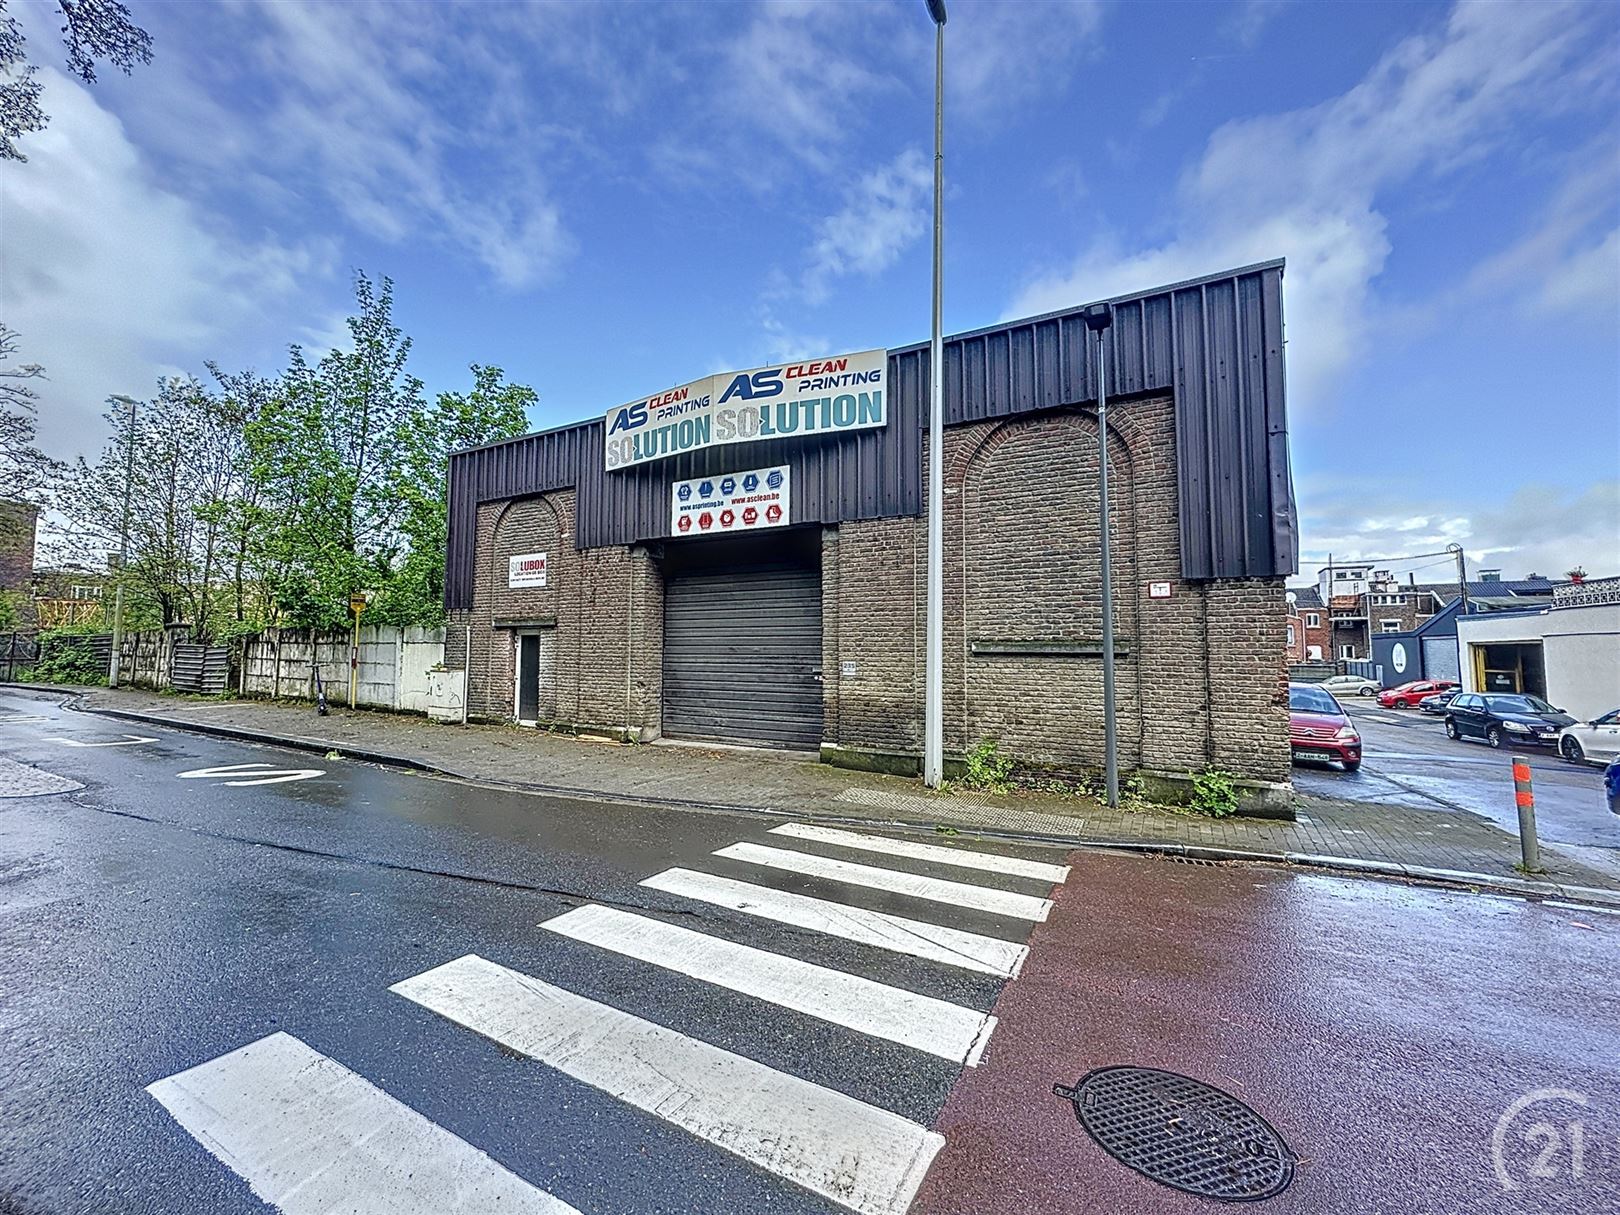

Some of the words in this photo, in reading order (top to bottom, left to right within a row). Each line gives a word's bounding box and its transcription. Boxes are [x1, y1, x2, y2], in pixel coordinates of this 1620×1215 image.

[718, 368, 784, 404] AS
[785, 358, 848, 379] CLEAN
[798, 369, 882, 392] PRINTING
[608, 400, 649, 435] AS
[649, 387, 689, 410] CLEAN
[656, 395, 711, 421] PRINTING
[716, 390, 882, 440] SOLUTION
[607, 414, 711, 467] SOLUTION
[680, 500, 724, 511] www.asprinting.be
[731, 493, 780, 505] www.asclean.be
[511, 559, 545, 573] SOLUBOX
